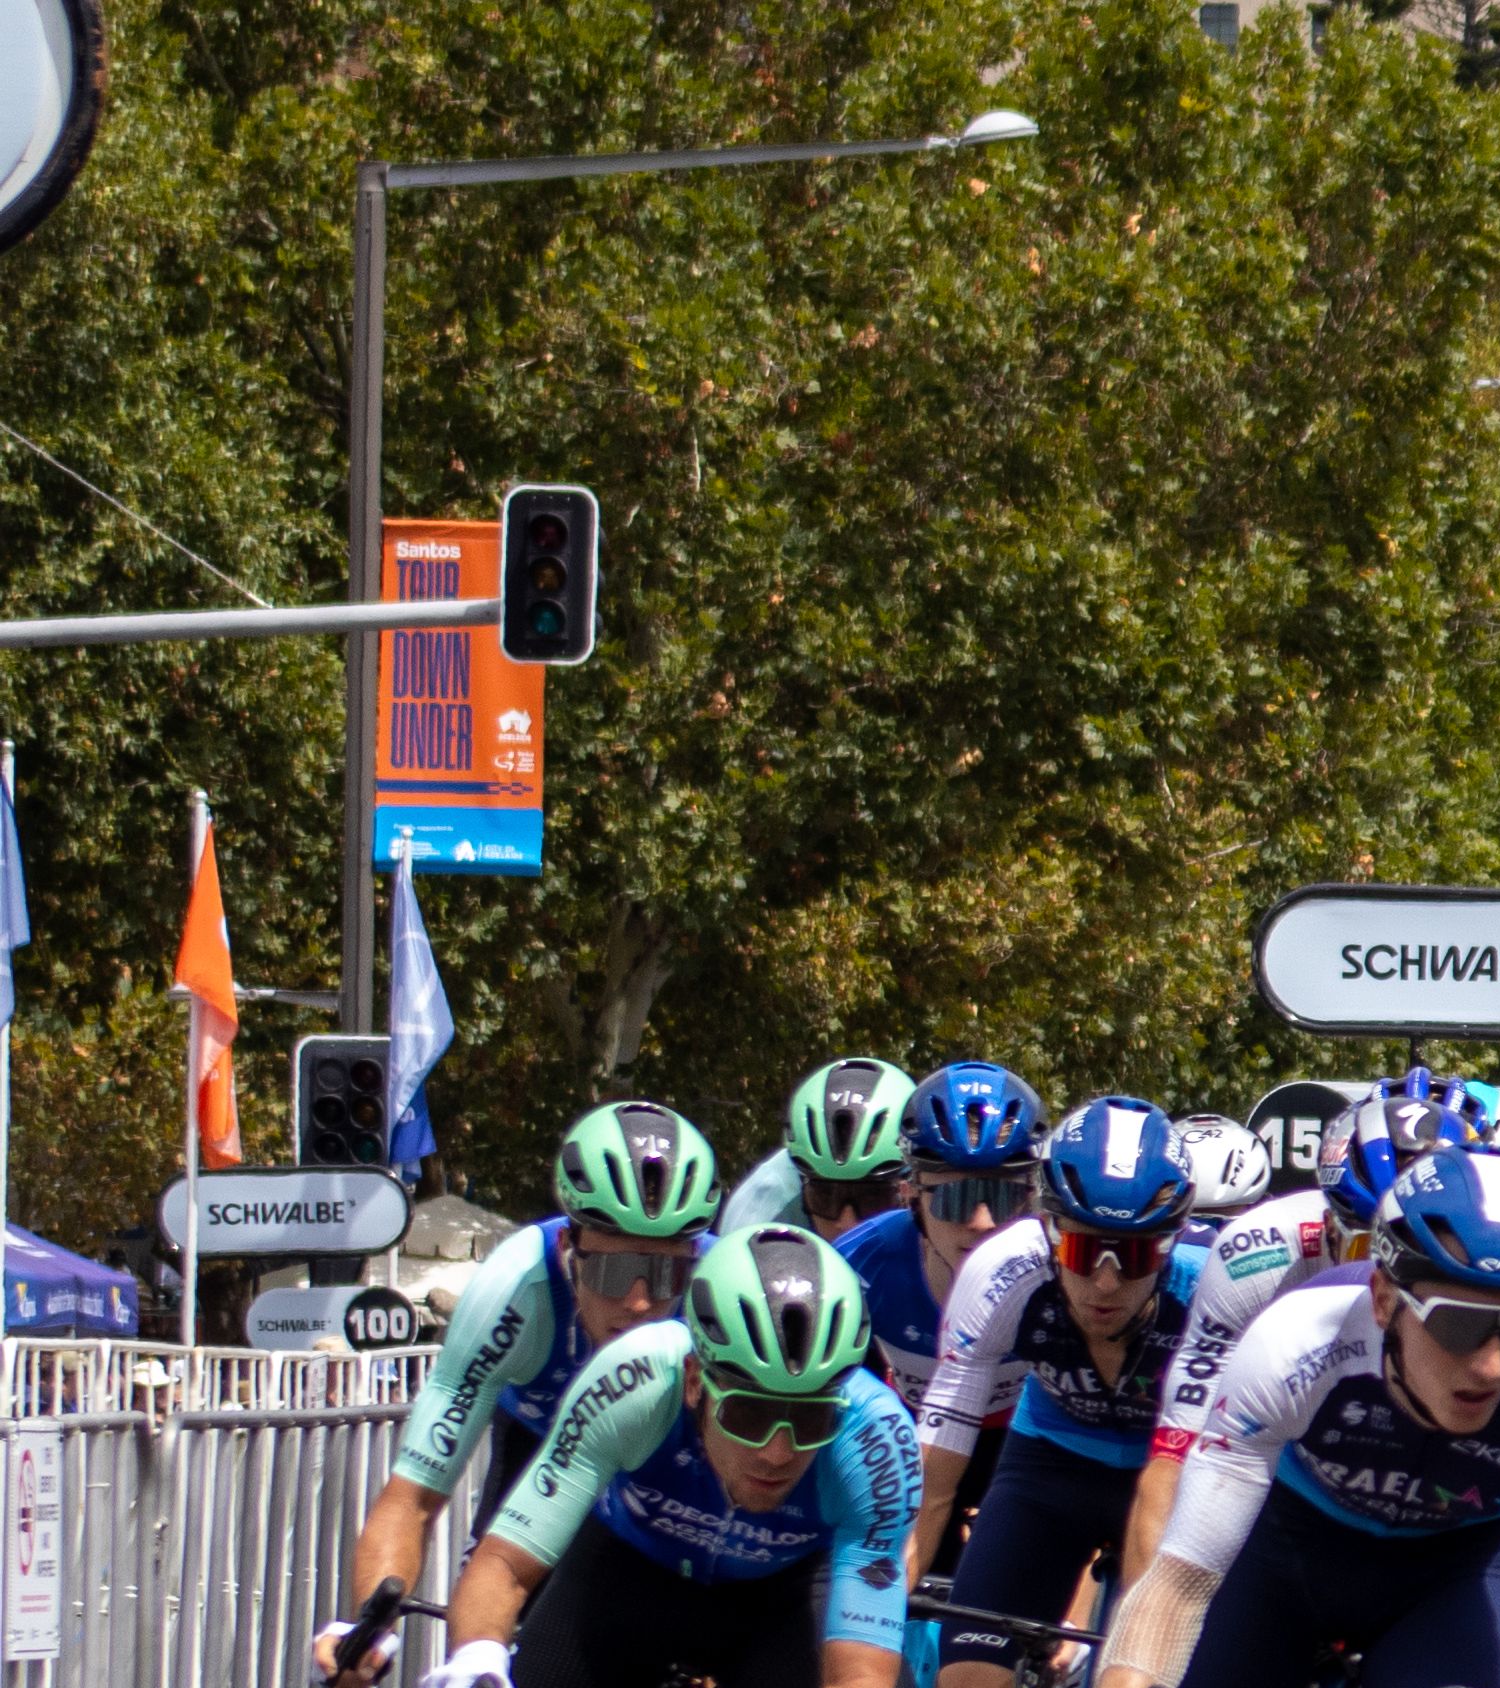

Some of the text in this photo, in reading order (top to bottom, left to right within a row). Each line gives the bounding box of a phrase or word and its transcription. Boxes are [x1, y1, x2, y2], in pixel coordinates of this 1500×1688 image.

[396, 541, 461, 559] Santos
[393, 631, 471, 699] DOWN
[390, 703, 473, 770] UNDER
[209, 1202, 345, 1225] SCHWALBE
[1219, 1227, 1285, 1261] BORA
[258, 1319, 327, 1332] SCHWALBE
[349, 1309, 408, 1339] 100
[446, 1306, 524, 1425] DECATHLON
[1175, 1320, 1230, 1406] BOSS
[1285, 1341, 1367, 1396] FANTINI
[552, 1355, 653, 1470] DECATHLON
[880, 1412, 920, 1476] AG2R
[855, 1424, 891, 1553] MONDIALE
